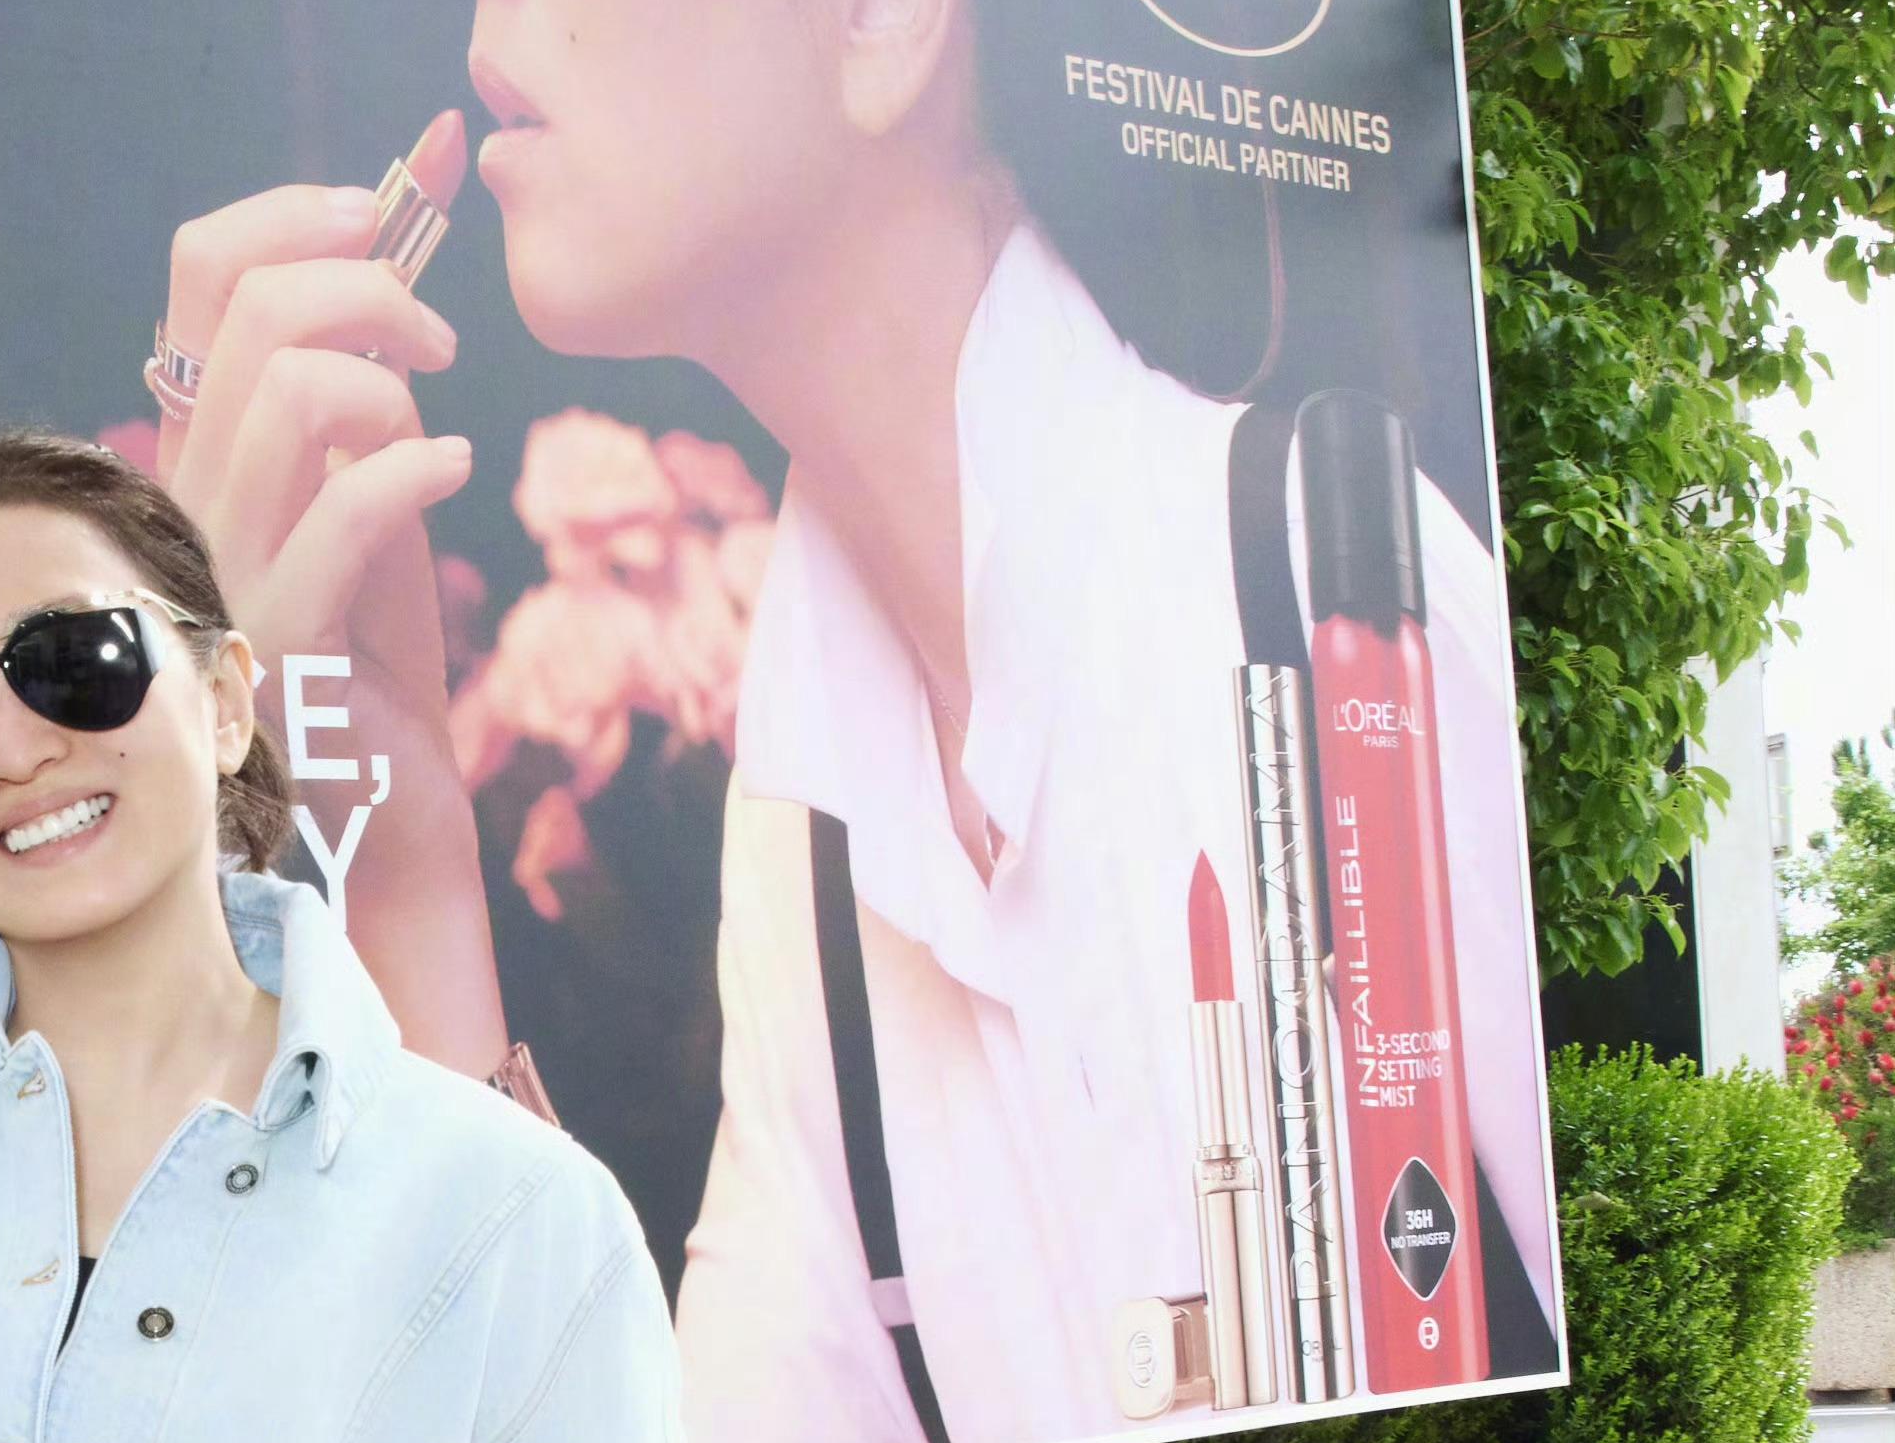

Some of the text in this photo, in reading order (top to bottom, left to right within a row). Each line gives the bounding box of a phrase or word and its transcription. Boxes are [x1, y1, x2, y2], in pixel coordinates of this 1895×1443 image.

[1065, 55, 1392, 154] FESTIVAL DE CANNES
[1121, 122, 1350, 192] OFFICIAL PARTNER
[1333, 698, 1425, 736] L'ORÉAL
[1335, 795, 1379, 1108] INFAILLIBLE
[1376, 1029, 1450, 1055] 3-SECOND
[1377, 1056, 1443, 1082] SETTING
[1379, 1085, 1417, 1107] MIST
[1405, 1208, 1434, 1230] 36H
[1390, 1231, 1451, 1249] NO TRANSFER
